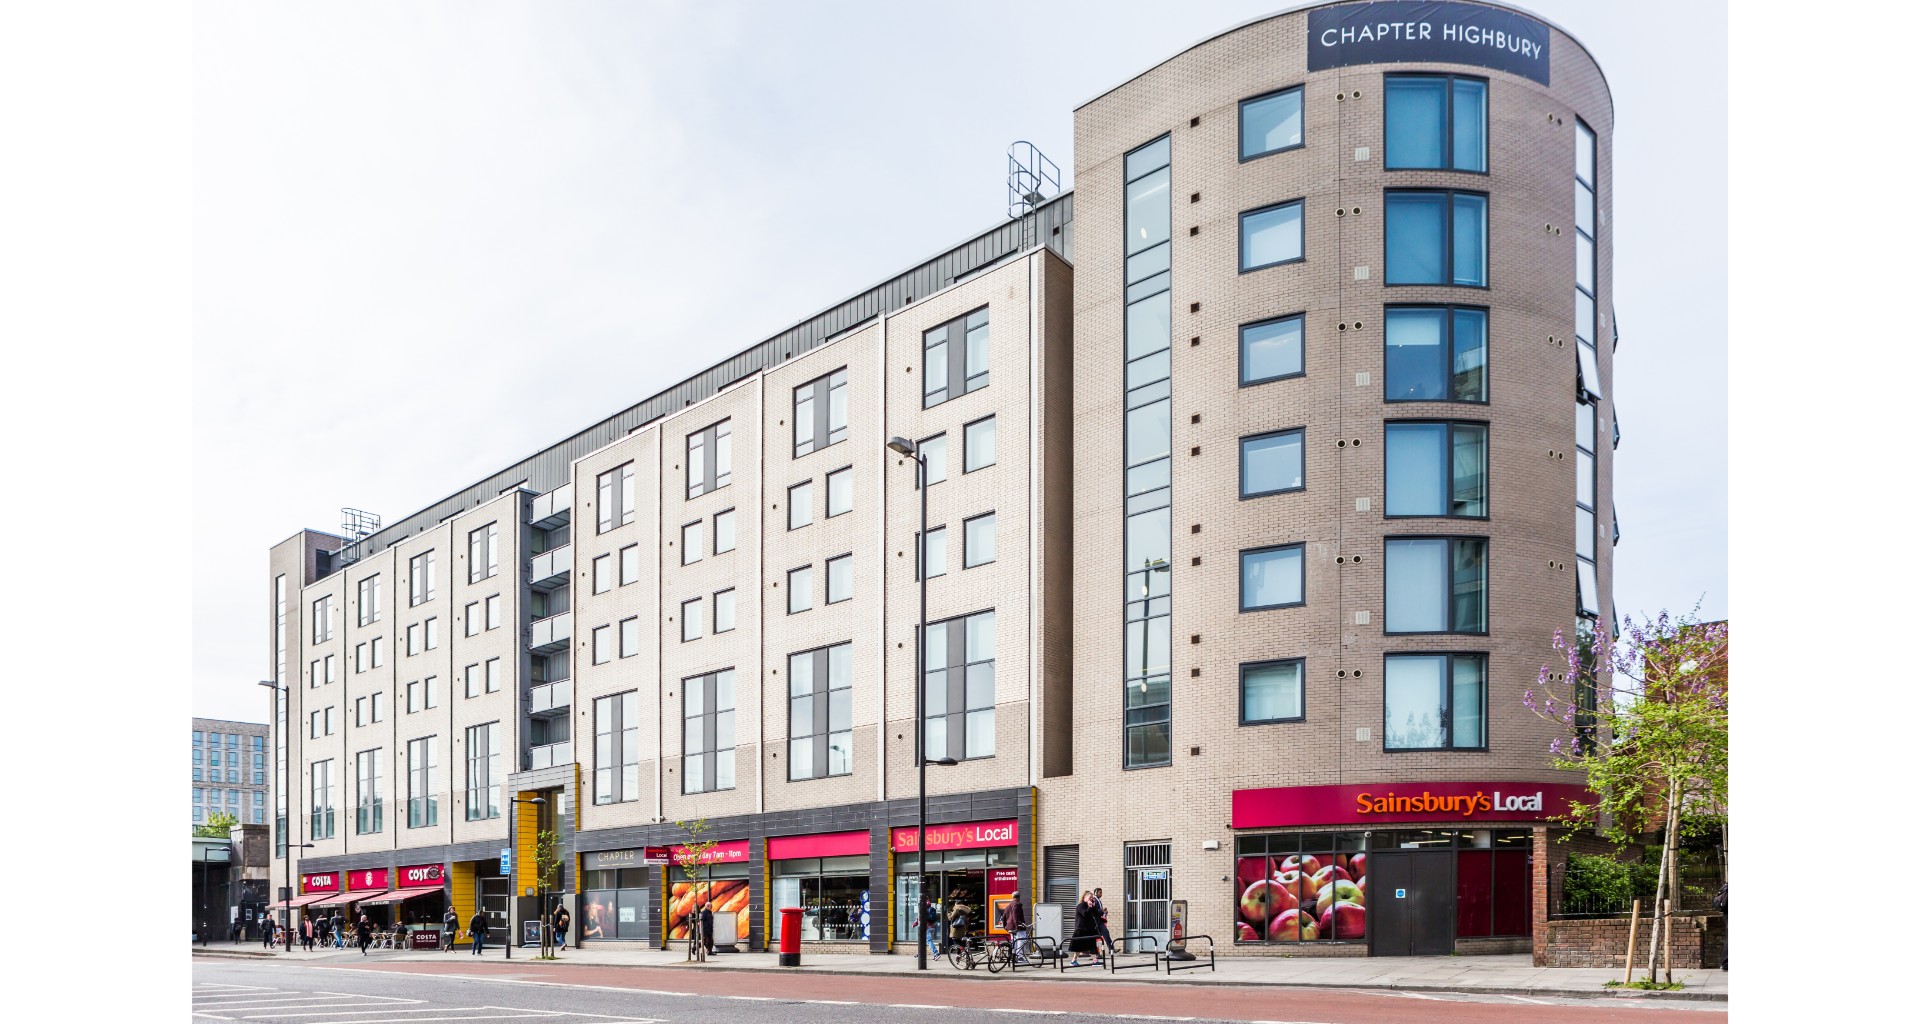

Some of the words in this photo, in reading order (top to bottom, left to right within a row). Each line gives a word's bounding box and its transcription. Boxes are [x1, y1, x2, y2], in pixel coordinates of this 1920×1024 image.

[1321, 22, 1432, 47] CHAPTER
[1443, 23, 1542, 60] HIGHBURY
[1356, 791, 1492, 816] Sainsbury's
[1493, 791, 1543, 812] Local
[898, 828, 974, 847] Saisbury's
[976, 824, 1013, 842] Local
[597, 850, 635, 862] CHAPTER
[728, 850, 742, 859] 11pm
[311, 875, 332, 887] COSTA
[408, 868, 430, 882] COST
